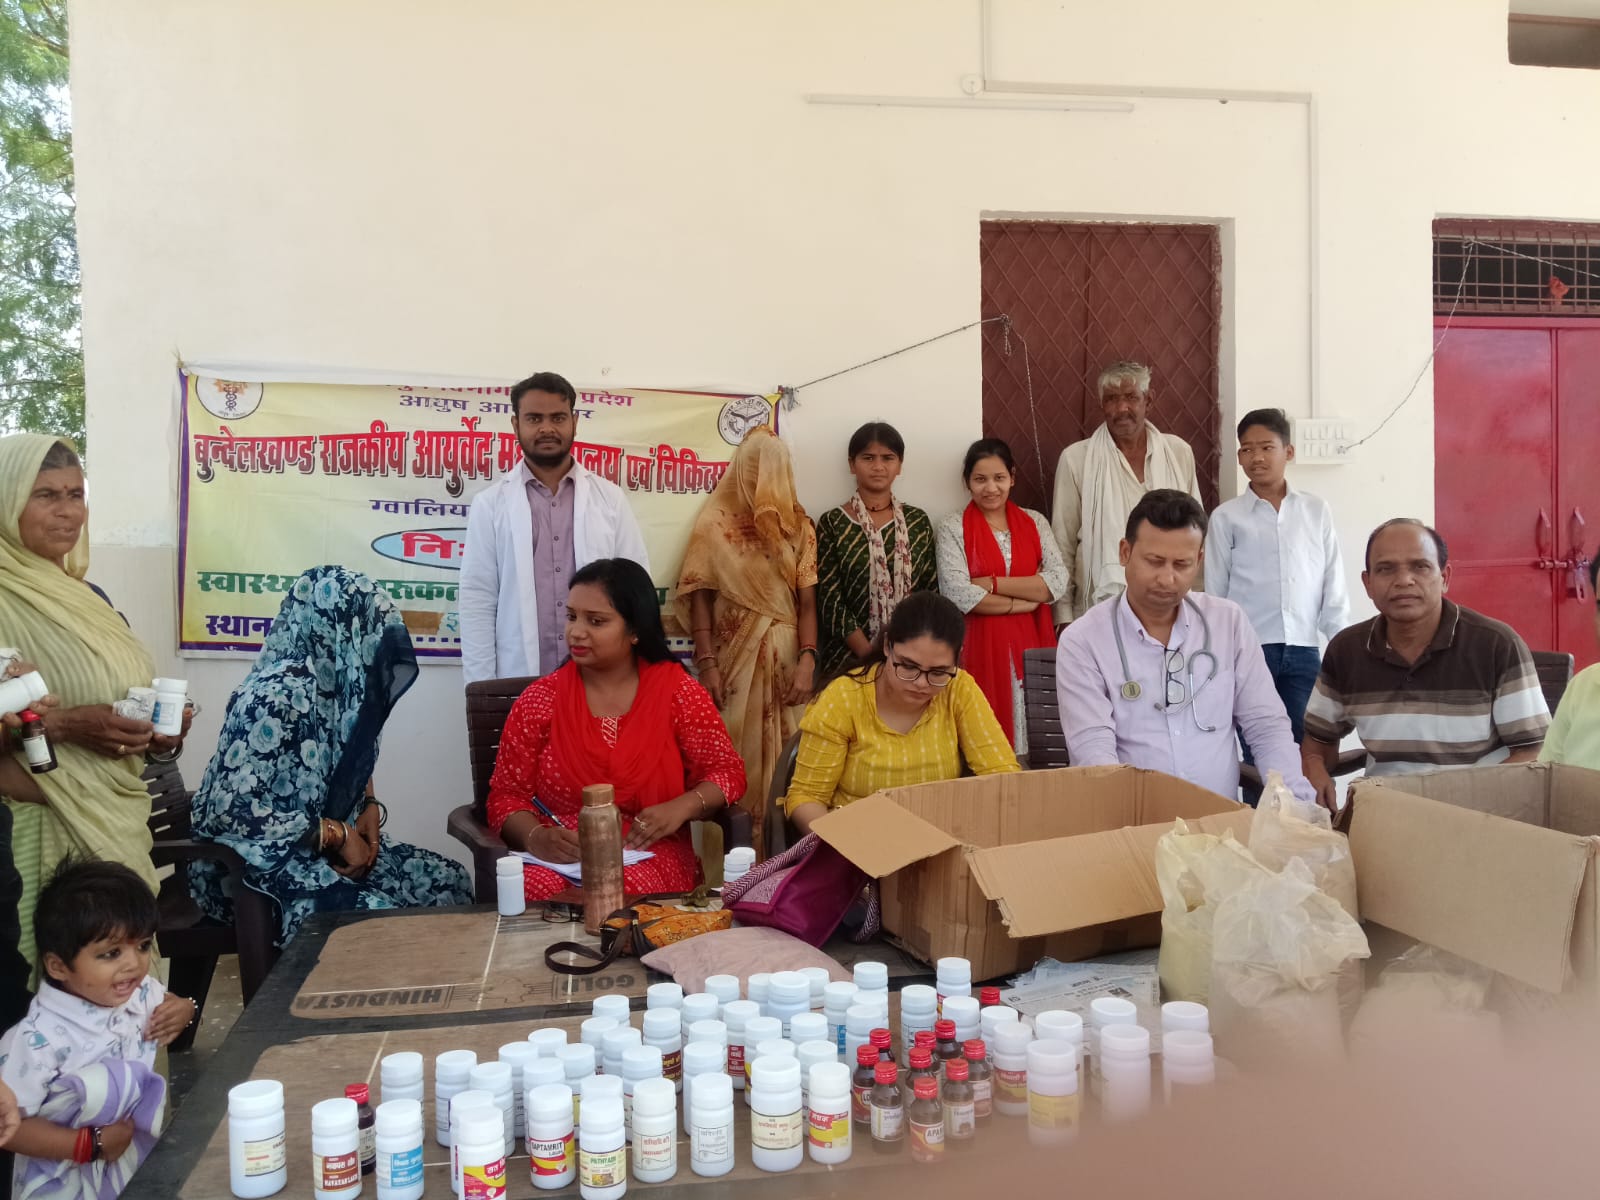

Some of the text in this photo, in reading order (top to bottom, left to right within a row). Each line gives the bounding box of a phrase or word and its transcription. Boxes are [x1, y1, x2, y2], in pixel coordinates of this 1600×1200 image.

[399, 395, 469, 413] आयुष
[580, 391, 636, 407] प्रदेश
[193, 425, 315, 482] बुन्देलखण्ड
[320, 419, 406, 477] राजकीय
[413, 416, 494, 497] आयुर्वेद
[625, 448, 656, 492] एवं
[205, 615, 274, 638] स्थान
[559, 972, 636, 993] GOLD
